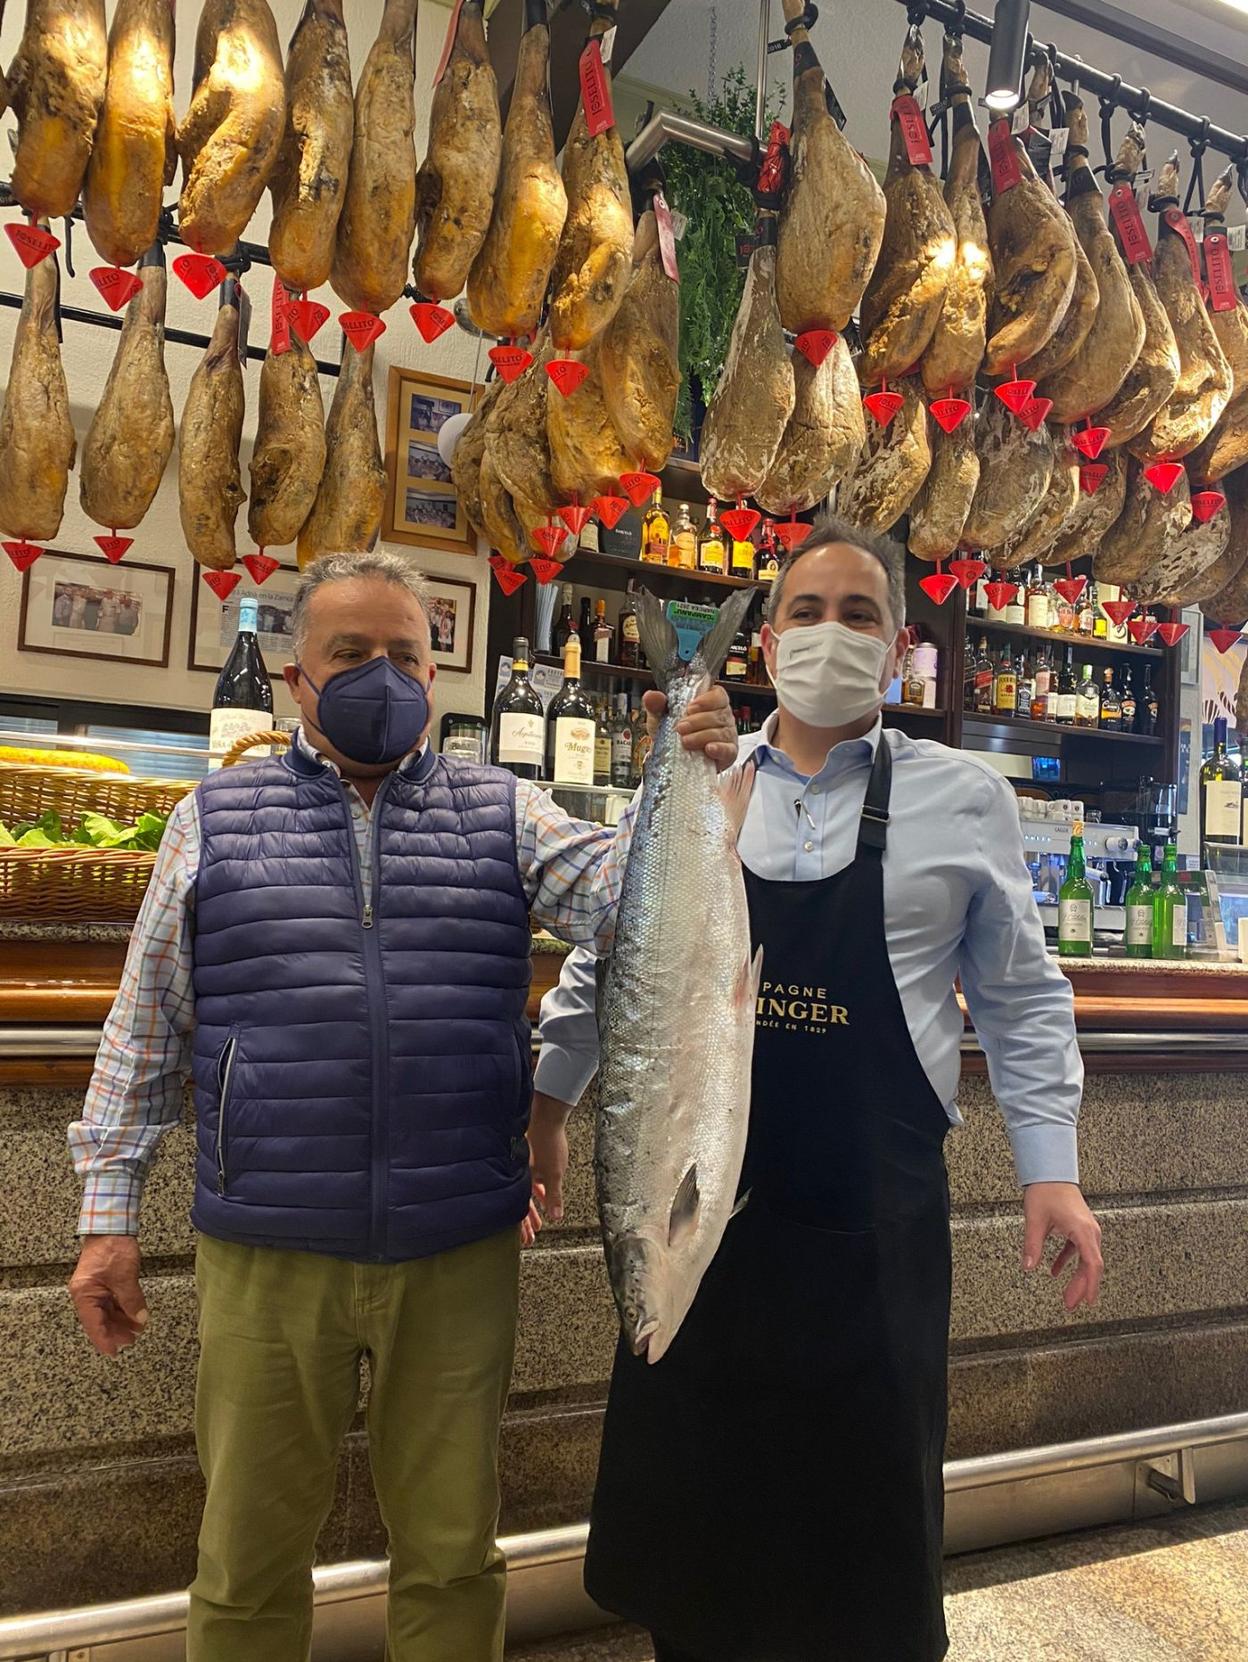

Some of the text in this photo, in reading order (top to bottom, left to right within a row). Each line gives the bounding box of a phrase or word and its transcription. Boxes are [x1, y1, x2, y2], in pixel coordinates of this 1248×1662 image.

[585, 61, 602, 115] JOSELITO
[1119, 202, 1139, 246] JOSELITO
[1211, 247, 1227, 296] JOSELITO
[763, 982, 827, 999] PAGNE
[756, 997, 850, 1025] INGER
[756, 1019, 779, 1028] NDÉE
